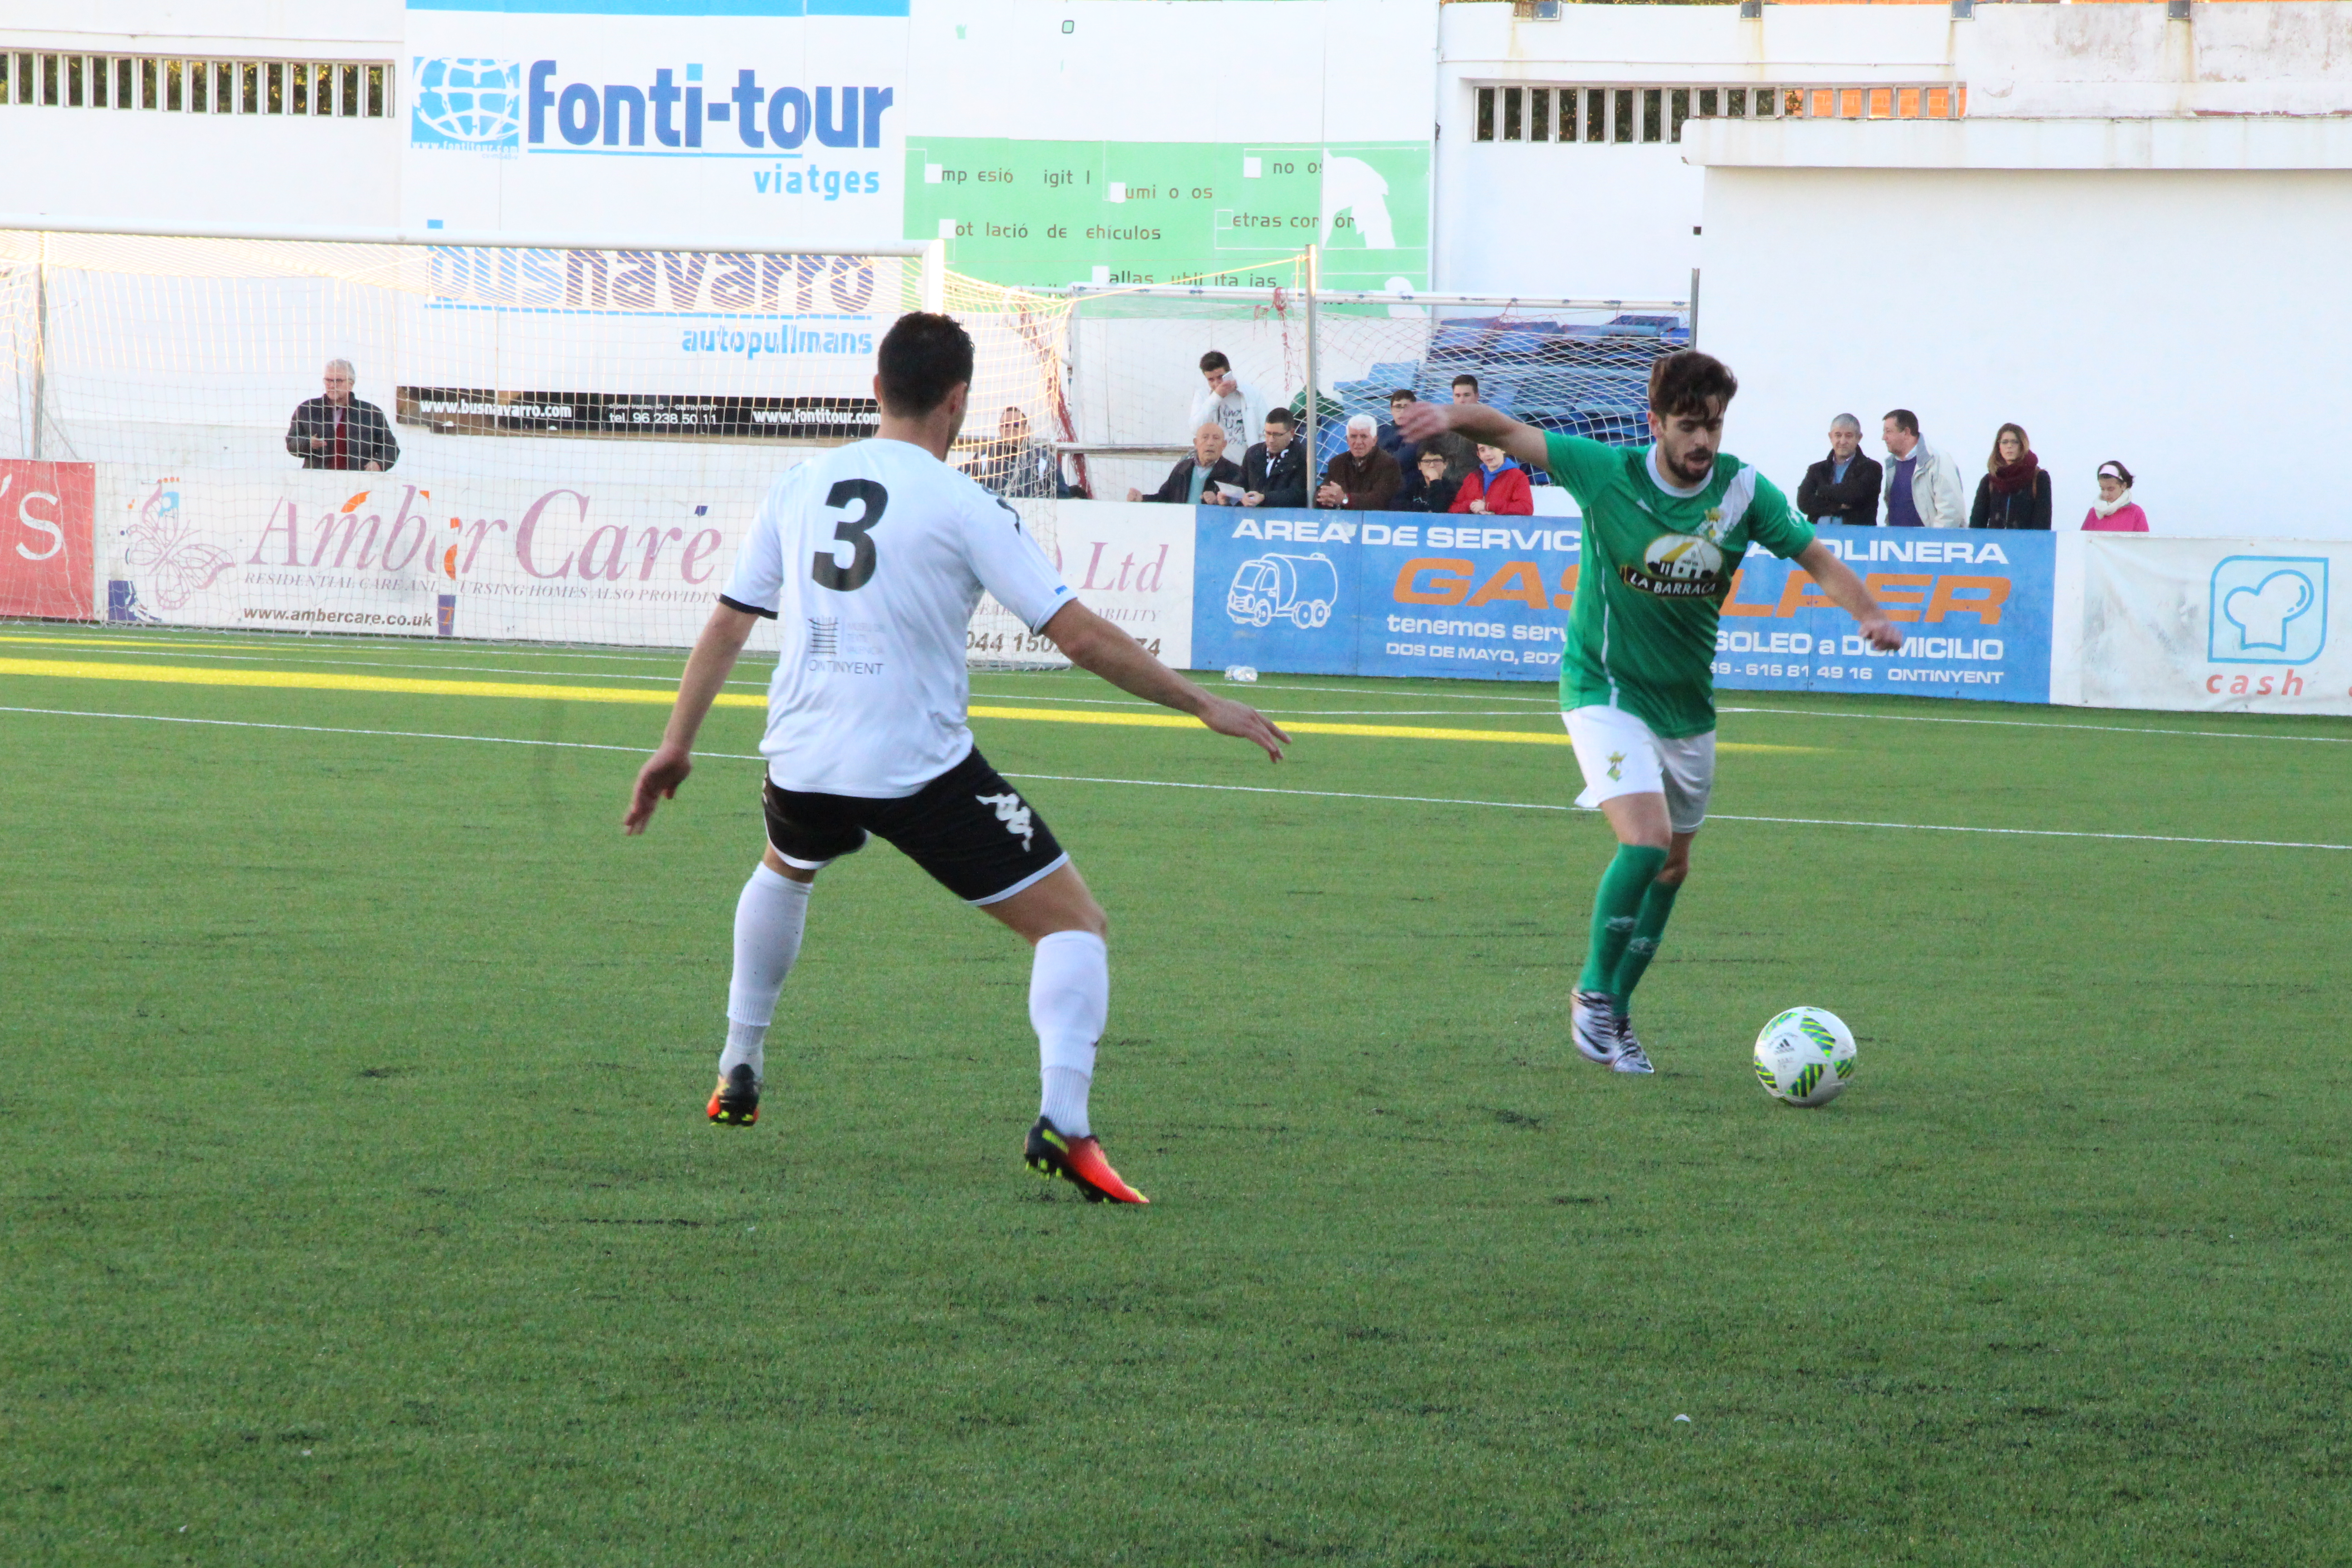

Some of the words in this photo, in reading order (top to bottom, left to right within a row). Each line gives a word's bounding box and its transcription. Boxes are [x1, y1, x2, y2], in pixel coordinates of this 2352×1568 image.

[528, 59, 893, 149] fonti-tour
[754, 163, 880, 201] viatges
[1047, 224, 1067, 239] de
[1087, 225, 1161, 240] ehículos
[1232, 212, 1282, 227] etras
[1109, 271, 1154, 284] allas
[682, 324, 873, 360] autopullmans
[420, 399, 572, 418] www.busnavarro.com
[633, 412, 650, 423] 96
[653, 413, 677, 424] 238
[682, 414, 698, 425] 50
[753, 408, 881, 425] www.fontitour.com
[812, 479, 888, 592] 3
[1232, 518, 1351, 544] AREA
[1362, 524, 1418, 547] DE
[1079, 542, 1169, 593] Ltd
[245, 573, 354, 588] RESIDENTIAL
[360, 577, 402, 591] CARE
[459, 581, 525, 597] URSING
[529, 585, 588, 598] HOMES
[591, 588, 634, 601] ALSO
[639, 590, 721, 604] PROVIDIN
[1089, 608, 1161, 622] ABILITY
[1630, 573, 1648, 589] LA
[1653, 581, 1716, 595] BARRACA
[244, 608, 434, 627] www.ambercare.co.uk
[1387, 614, 1506, 639] tenemos
[1819, 640, 1835, 655] a
[1386, 642, 1426, 657] DOS
[1430, 645, 1455, 658] DE
[1458, 647, 1519, 665] MAYO,
[1746, 664, 1783, 676] 616
[1787, 665, 1809, 677] 81
[1817, 666, 1843, 679] 49
[1849, 667, 1872, 680] 16
[1888, 668, 2004, 685] ONTINYENT
[2206, 669, 2305, 696] cash
